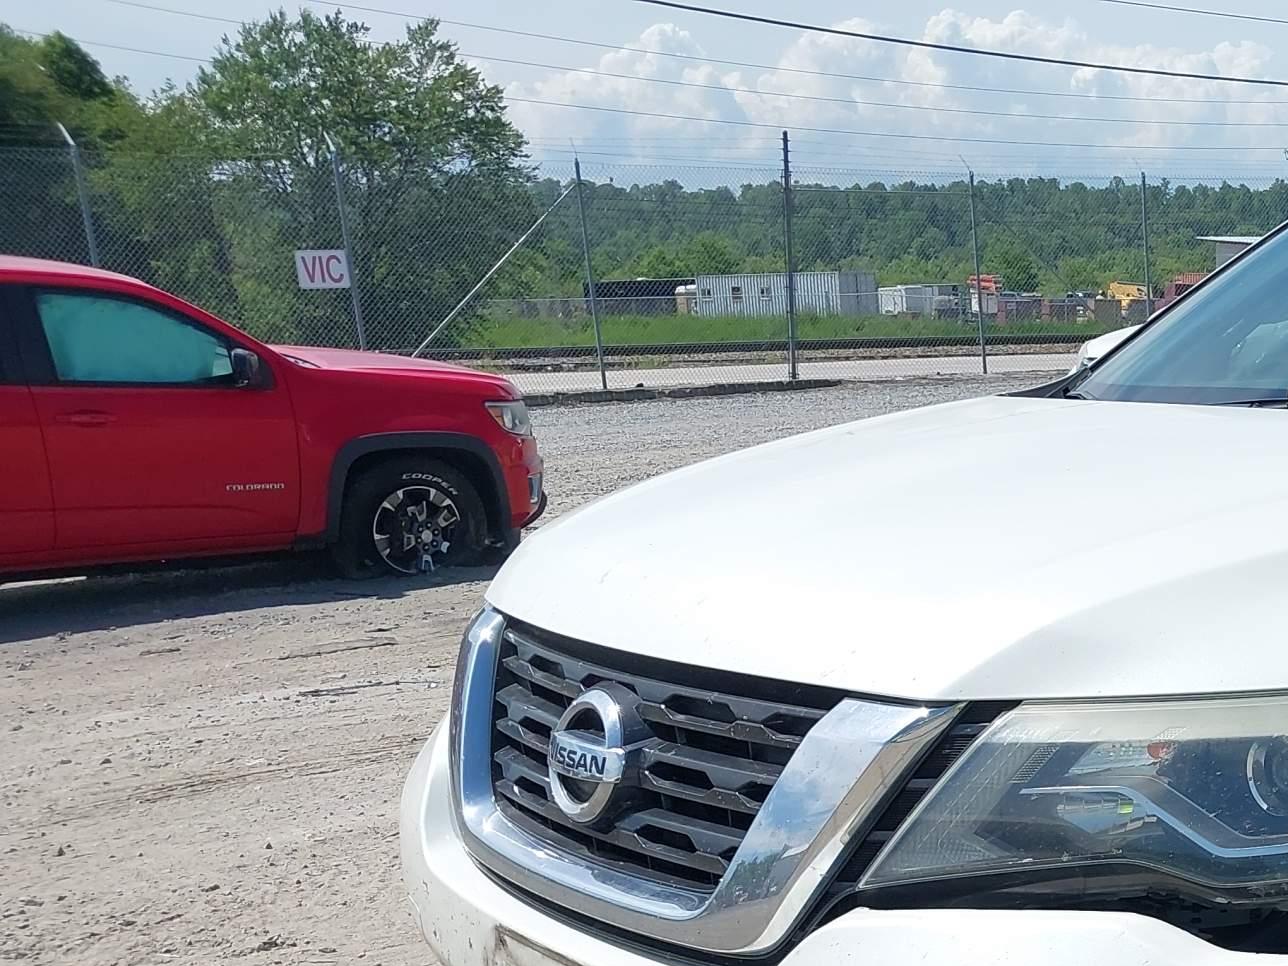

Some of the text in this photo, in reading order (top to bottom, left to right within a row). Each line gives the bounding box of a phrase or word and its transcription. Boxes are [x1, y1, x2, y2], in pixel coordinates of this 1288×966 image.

[301, 255, 344, 283] VIC
[226, 482, 285, 491] COLORADO
[402, 472, 459, 496] COOPER
[550, 740, 607, 775] NISSAN
